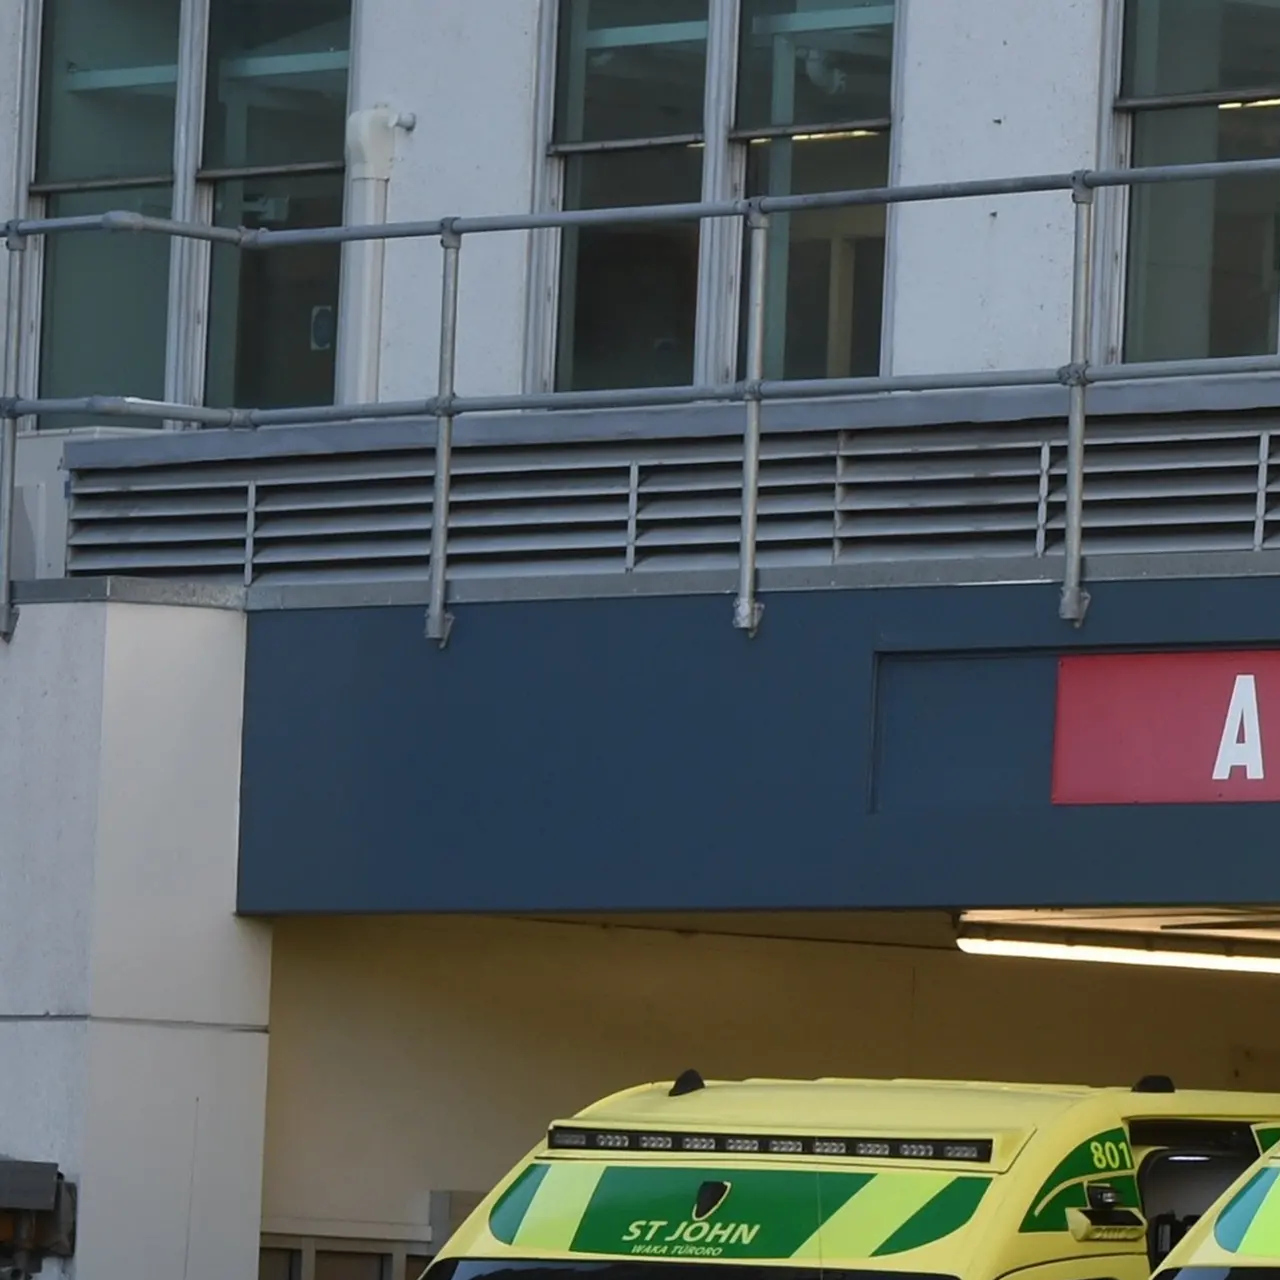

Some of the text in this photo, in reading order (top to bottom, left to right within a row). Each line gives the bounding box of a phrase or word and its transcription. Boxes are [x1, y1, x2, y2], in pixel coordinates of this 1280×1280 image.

[1090, 1140, 1132, 1169] 801
[621, 1220, 761, 1245] ST JOHN
[631, 1244, 668, 1255] WAKA
